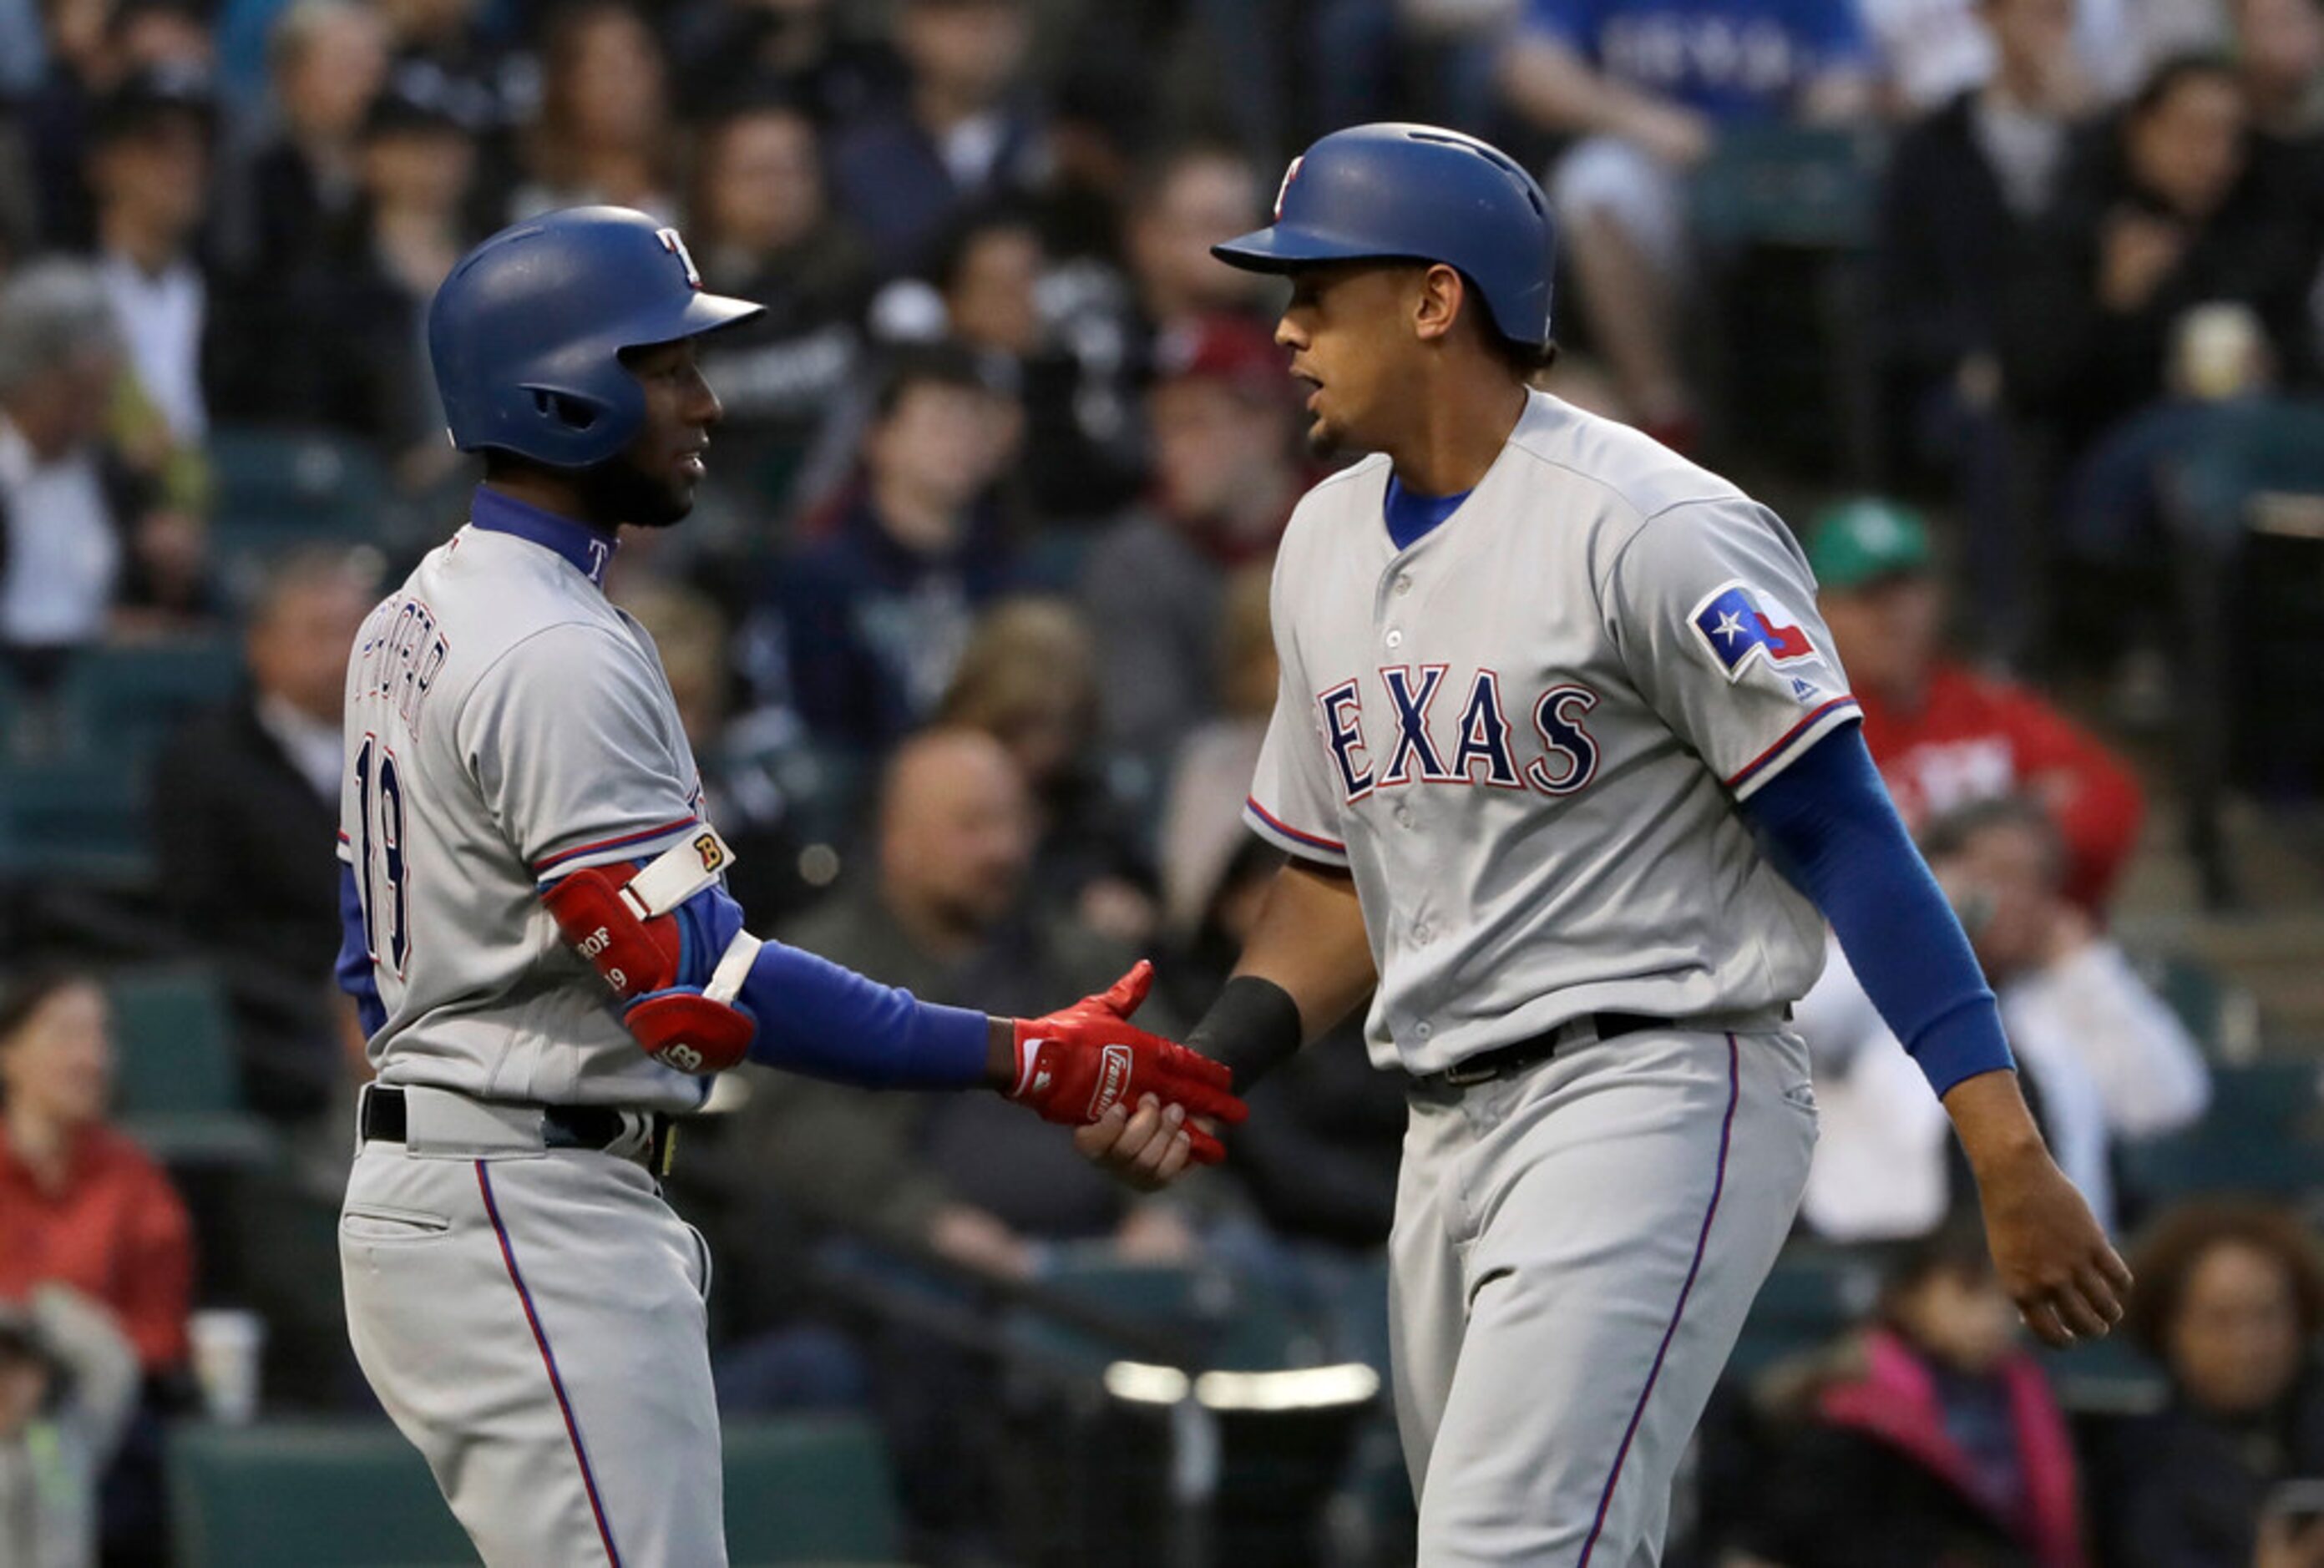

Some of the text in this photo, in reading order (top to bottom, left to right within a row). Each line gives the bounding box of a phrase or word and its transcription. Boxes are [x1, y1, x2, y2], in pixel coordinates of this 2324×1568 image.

[655, 227, 703, 288] T
[588, 538, 609, 580] T
[1316, 664, 1601, 806] EXAS
[354, 731, 411, 982] 19
[693, 833, 724, 873] B
